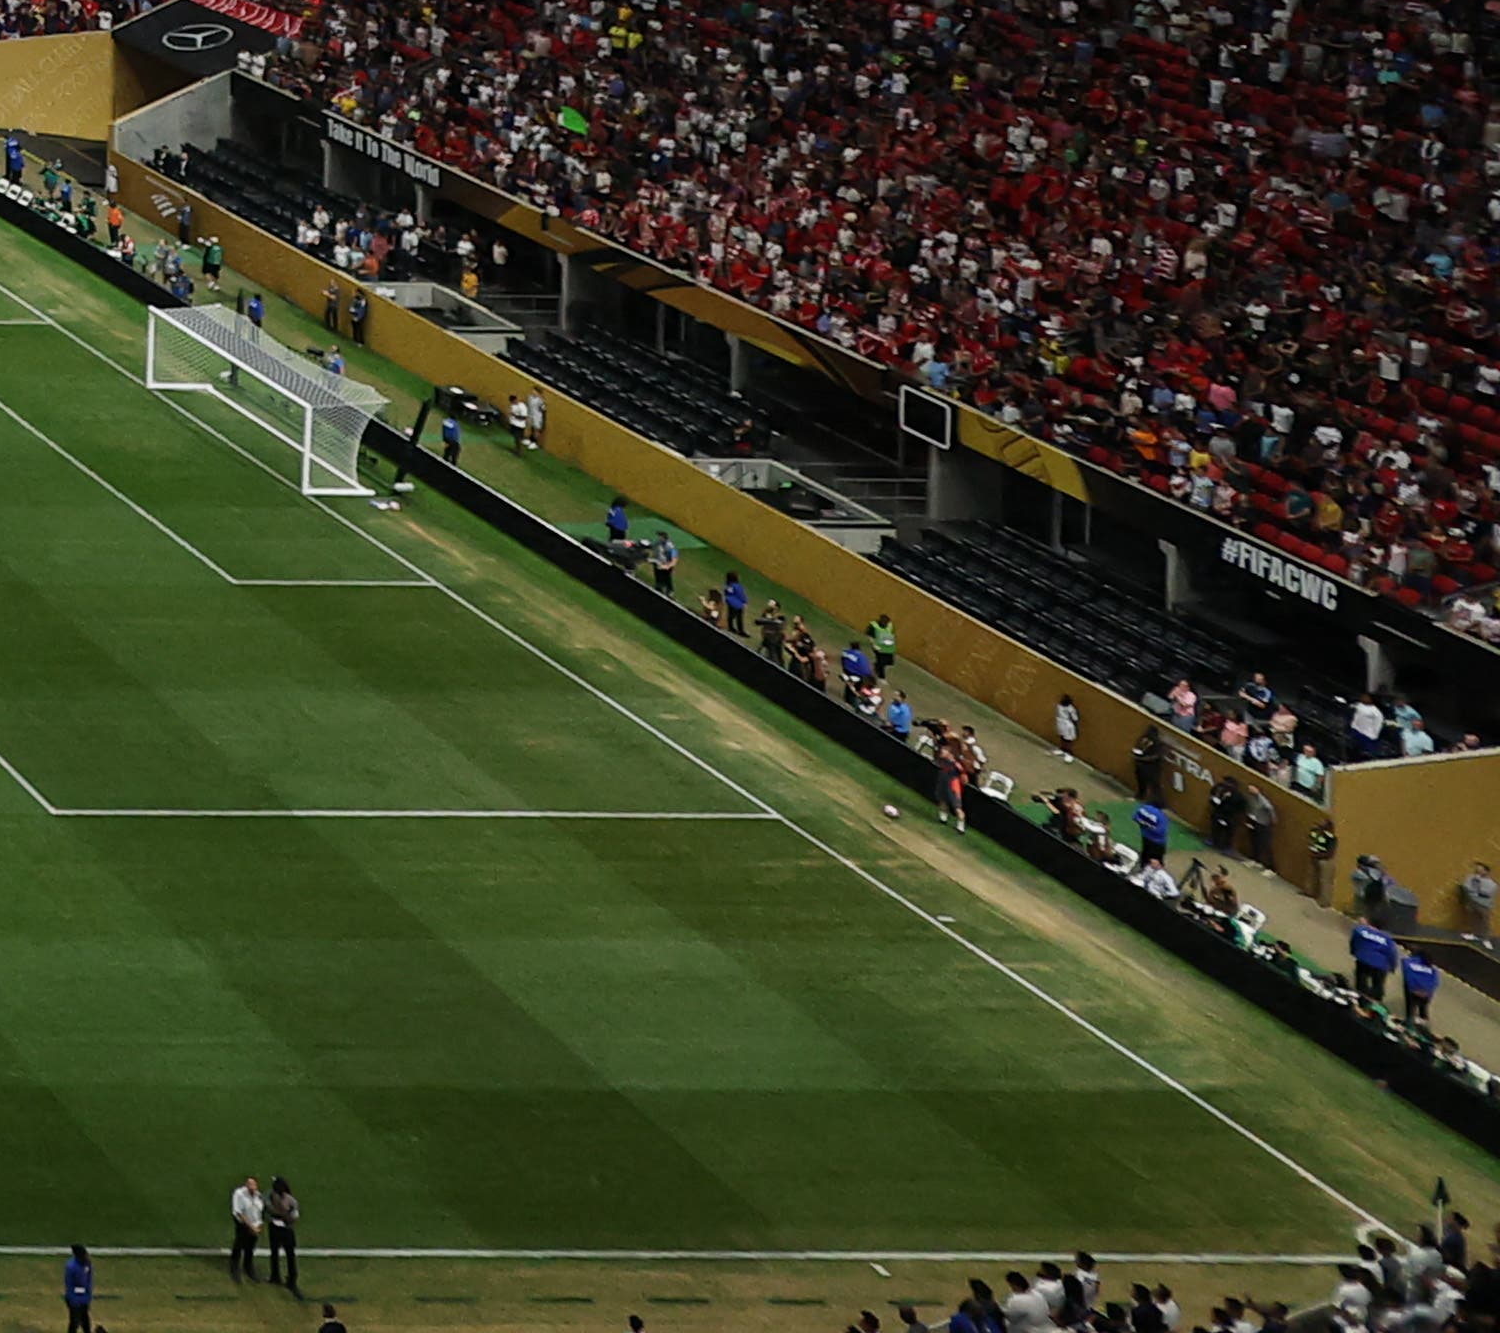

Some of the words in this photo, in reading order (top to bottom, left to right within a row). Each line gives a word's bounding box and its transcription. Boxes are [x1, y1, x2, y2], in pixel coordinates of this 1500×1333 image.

[327, 118, 353, 146] Take
[366, 132, 379, 158] To
[381, 140, 401, 169] The
[403, 154, 440, 188] World
[1221, 537, 1338, 611] #FIFACWC
